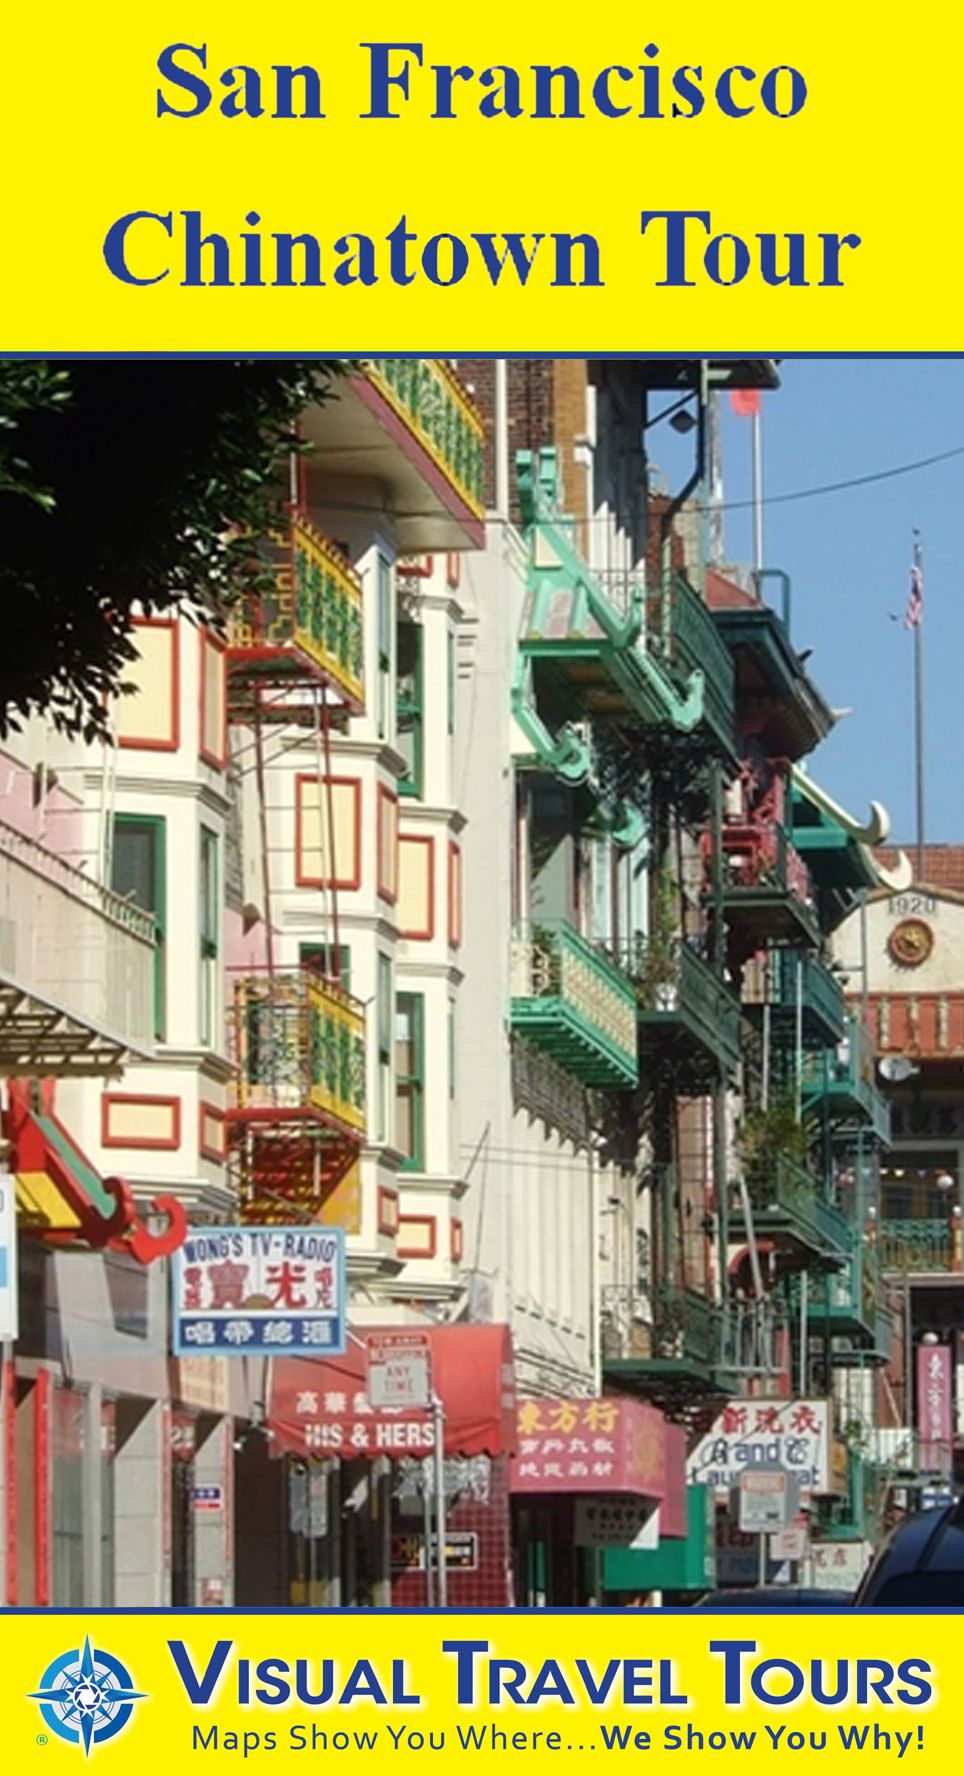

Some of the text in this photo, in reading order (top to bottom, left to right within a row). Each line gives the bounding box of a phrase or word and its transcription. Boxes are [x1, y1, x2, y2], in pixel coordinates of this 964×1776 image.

[887, 898, 937, 914] 1920
[183, 1233, 244, 1263] WONG'S
[517, 1401, 619, 1435] 東方行
[305, 1423, 435, 1447] HIS & HERS
[735, 1439, 781, 1463] and
